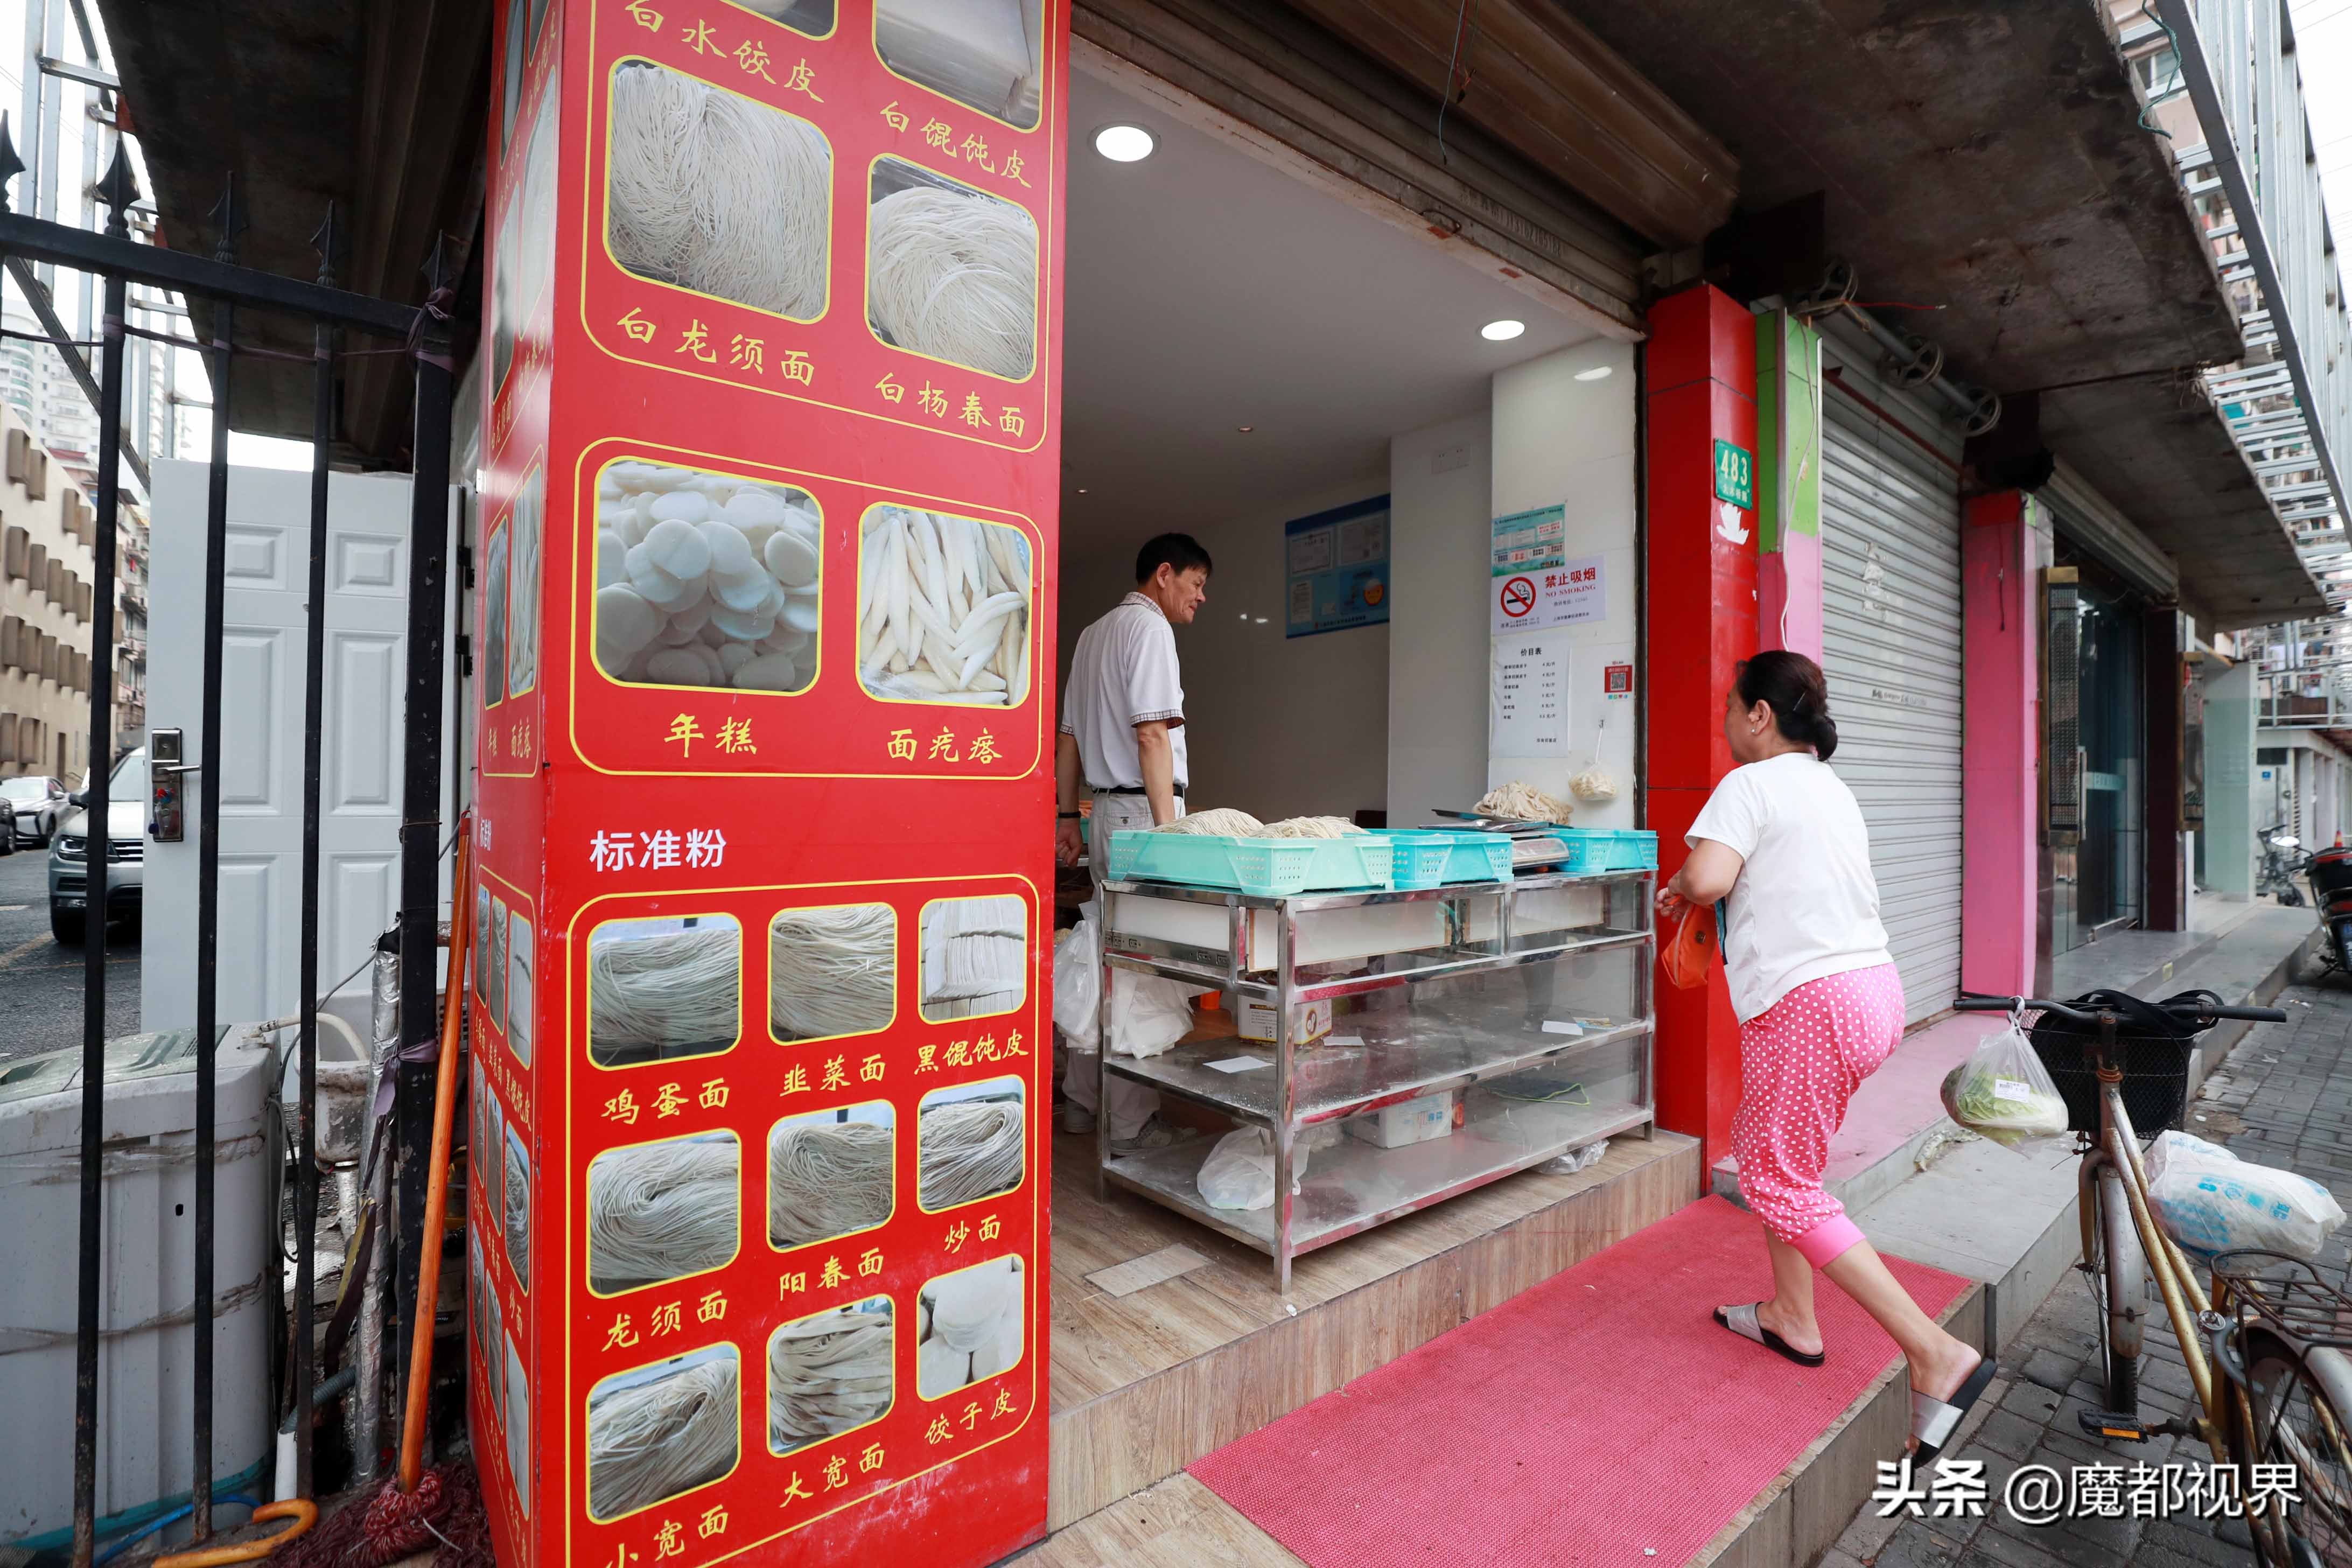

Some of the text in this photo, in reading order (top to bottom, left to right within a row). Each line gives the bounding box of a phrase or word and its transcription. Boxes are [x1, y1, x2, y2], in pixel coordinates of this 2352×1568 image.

[625, 0, 823, 102] 白水饺皮
[880, 101, 1031, 187] 白馄饨皮
[617, 307, 815, 386] 白龙须面
[875, 372, 1025, 437] 白杨春面
[1721, 450, 1748, 486] 483
[1545, 567, 1596, 589] 禁止吸烟
[1559, 584, 1596, 596] SMOKING
[1521, 647, 1542, 656] 价目表
[664, 713, 757, 758] 年糕
[887, 727, 1002, 764] 面疙瘩
[589, 829, 726, 872] 标准粉
[914, 1029, 1029, 1075] 黑馄饨皮
[780, 1054, 886, 1097] 韭菜面
[601, 1078, 730, 1125] 鸡蛋面
[944, 1214, 1001, 1254] 炒面
[779, 1248, 884, 1300] 阳春面
[601, 1291, 727, 1352] 龙须面
[925, 1388, 1017, 1445] 饺子皮
[779, 1443, 885, 1508] 大宽面
[605, 1504, 729, 1568] 小宽面
